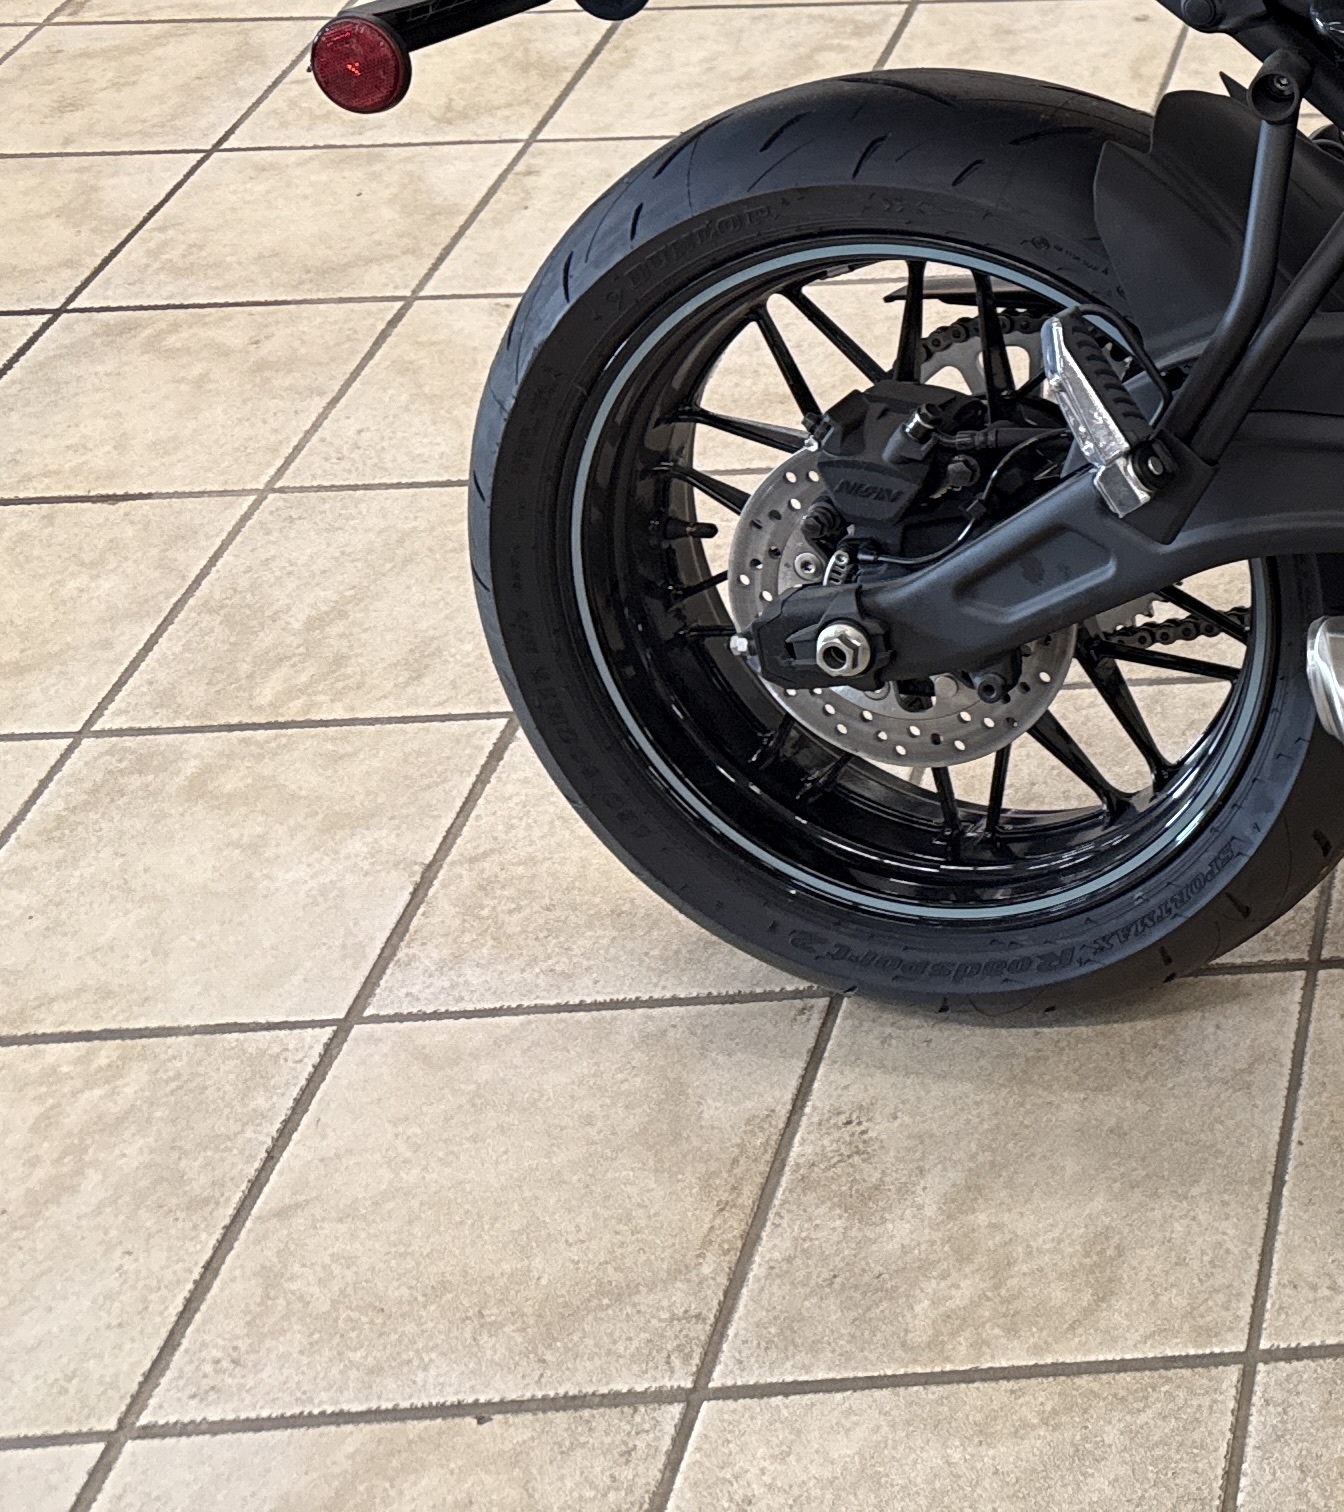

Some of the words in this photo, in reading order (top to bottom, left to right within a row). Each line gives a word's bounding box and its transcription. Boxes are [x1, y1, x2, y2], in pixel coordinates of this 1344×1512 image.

[625, 205, 773, 287] DUNLOP
[1092, 840, 1238, 955] SPORTMAX
[826, 941, 1077, 984] Roadsport
